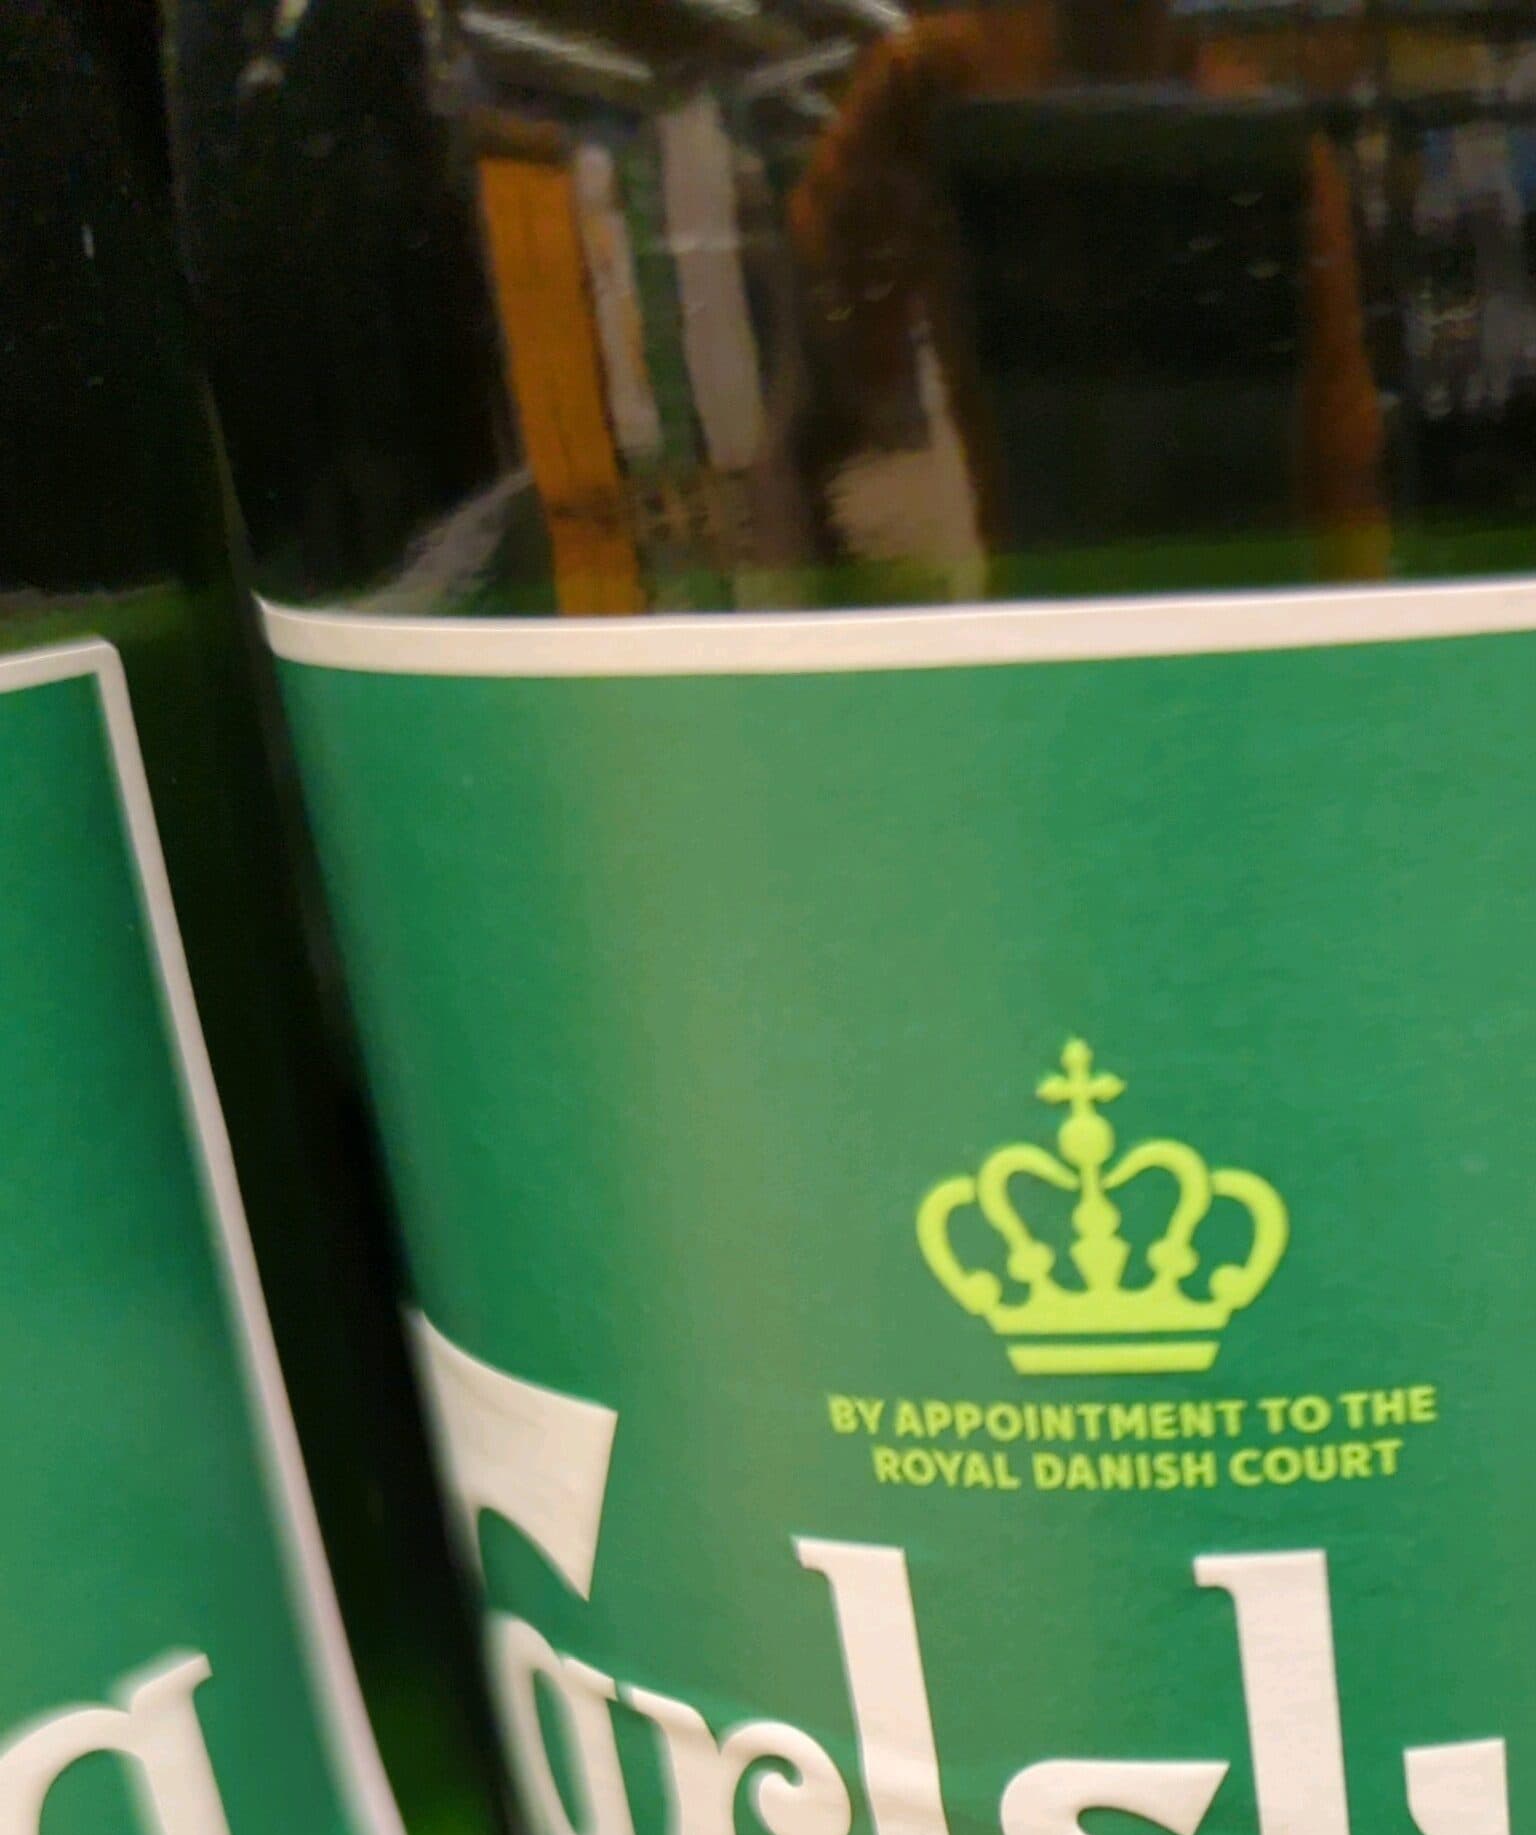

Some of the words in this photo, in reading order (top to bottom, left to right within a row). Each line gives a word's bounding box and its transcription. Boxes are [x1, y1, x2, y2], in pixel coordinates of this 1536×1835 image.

[826, 1394, 884, 1435] BY
[894, 1400, 1244, 1441] APPOINTMENT
[1260, 1396, 1330, 1432] TO
[1341, 1386, 1436, 1427] THE
[871, 1446, 1020, 1489] ROYAL
[1033, 1452, 1215, 1489] DANISH
[1229, 1439, 1402, 1485] COURT
